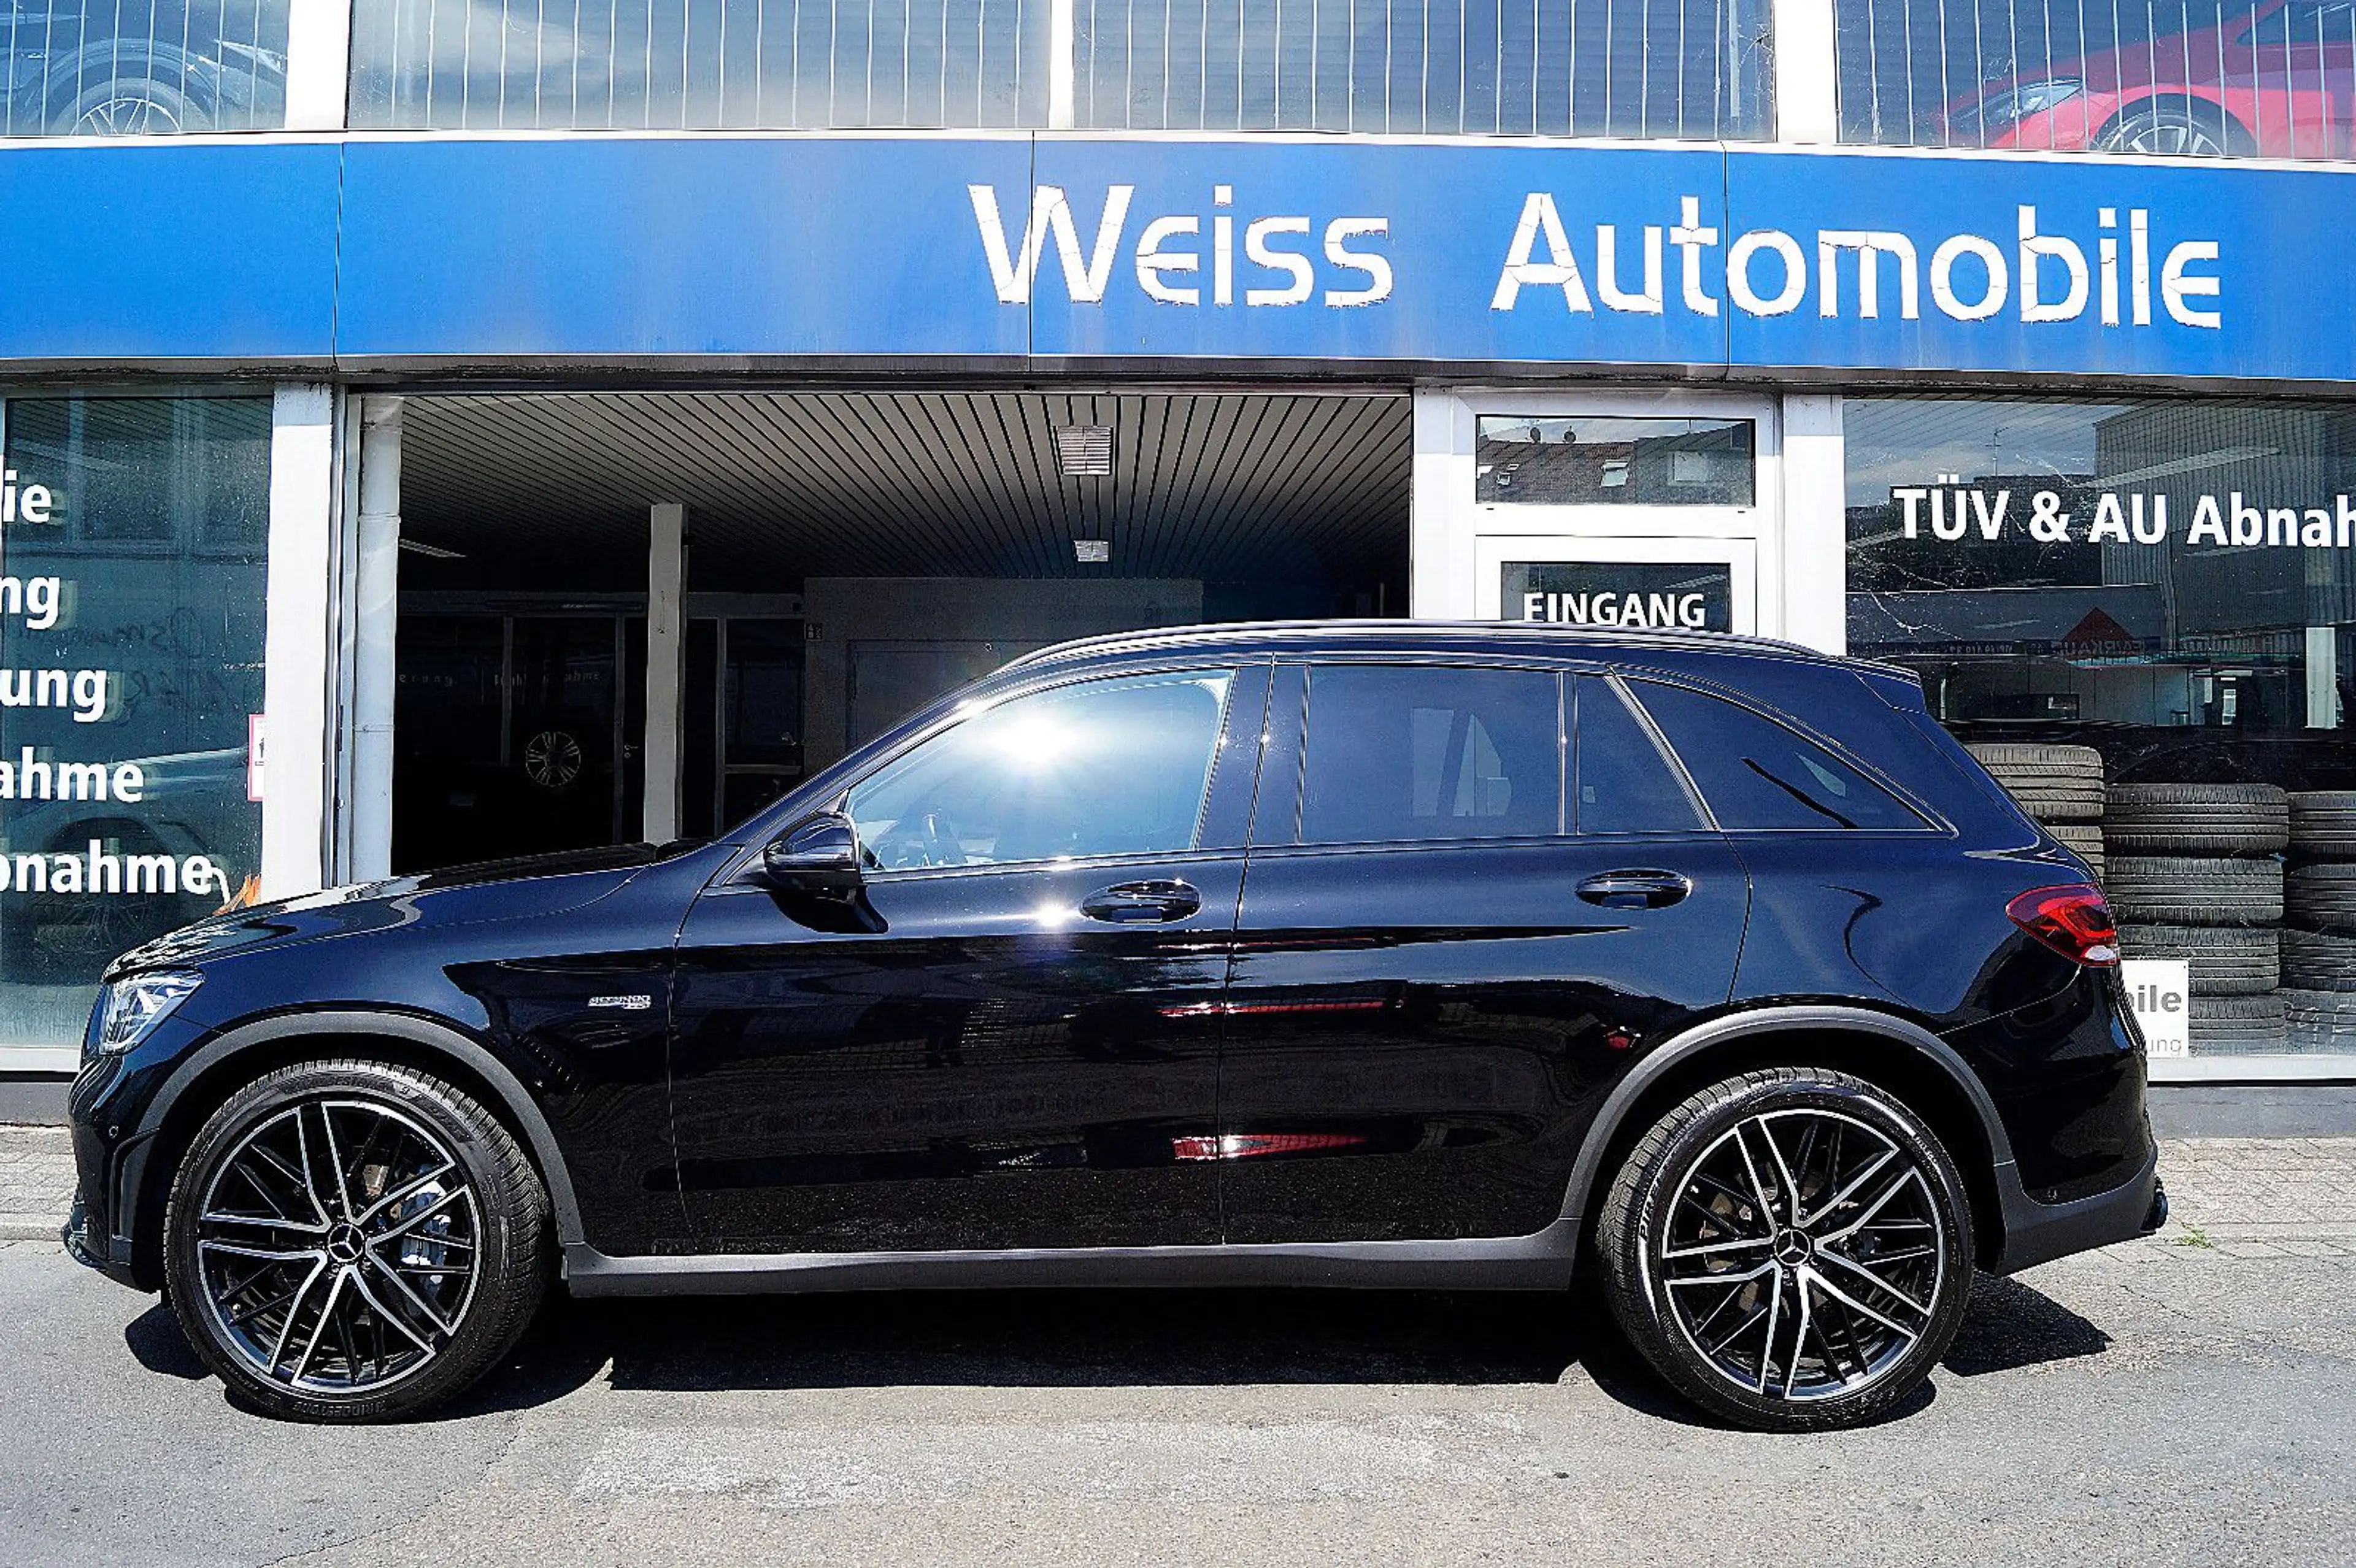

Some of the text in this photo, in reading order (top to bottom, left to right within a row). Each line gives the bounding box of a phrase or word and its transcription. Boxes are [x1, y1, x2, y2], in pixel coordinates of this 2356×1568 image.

[967, 185, 2222, 329] Weiss Automobile
[1893, 474, 2010, 540] TÜV
[2029, 490, 2071, 544] &
[2087, 493, 2169, 544] AU
[1523, 592, 1706, 627] EINGANG
